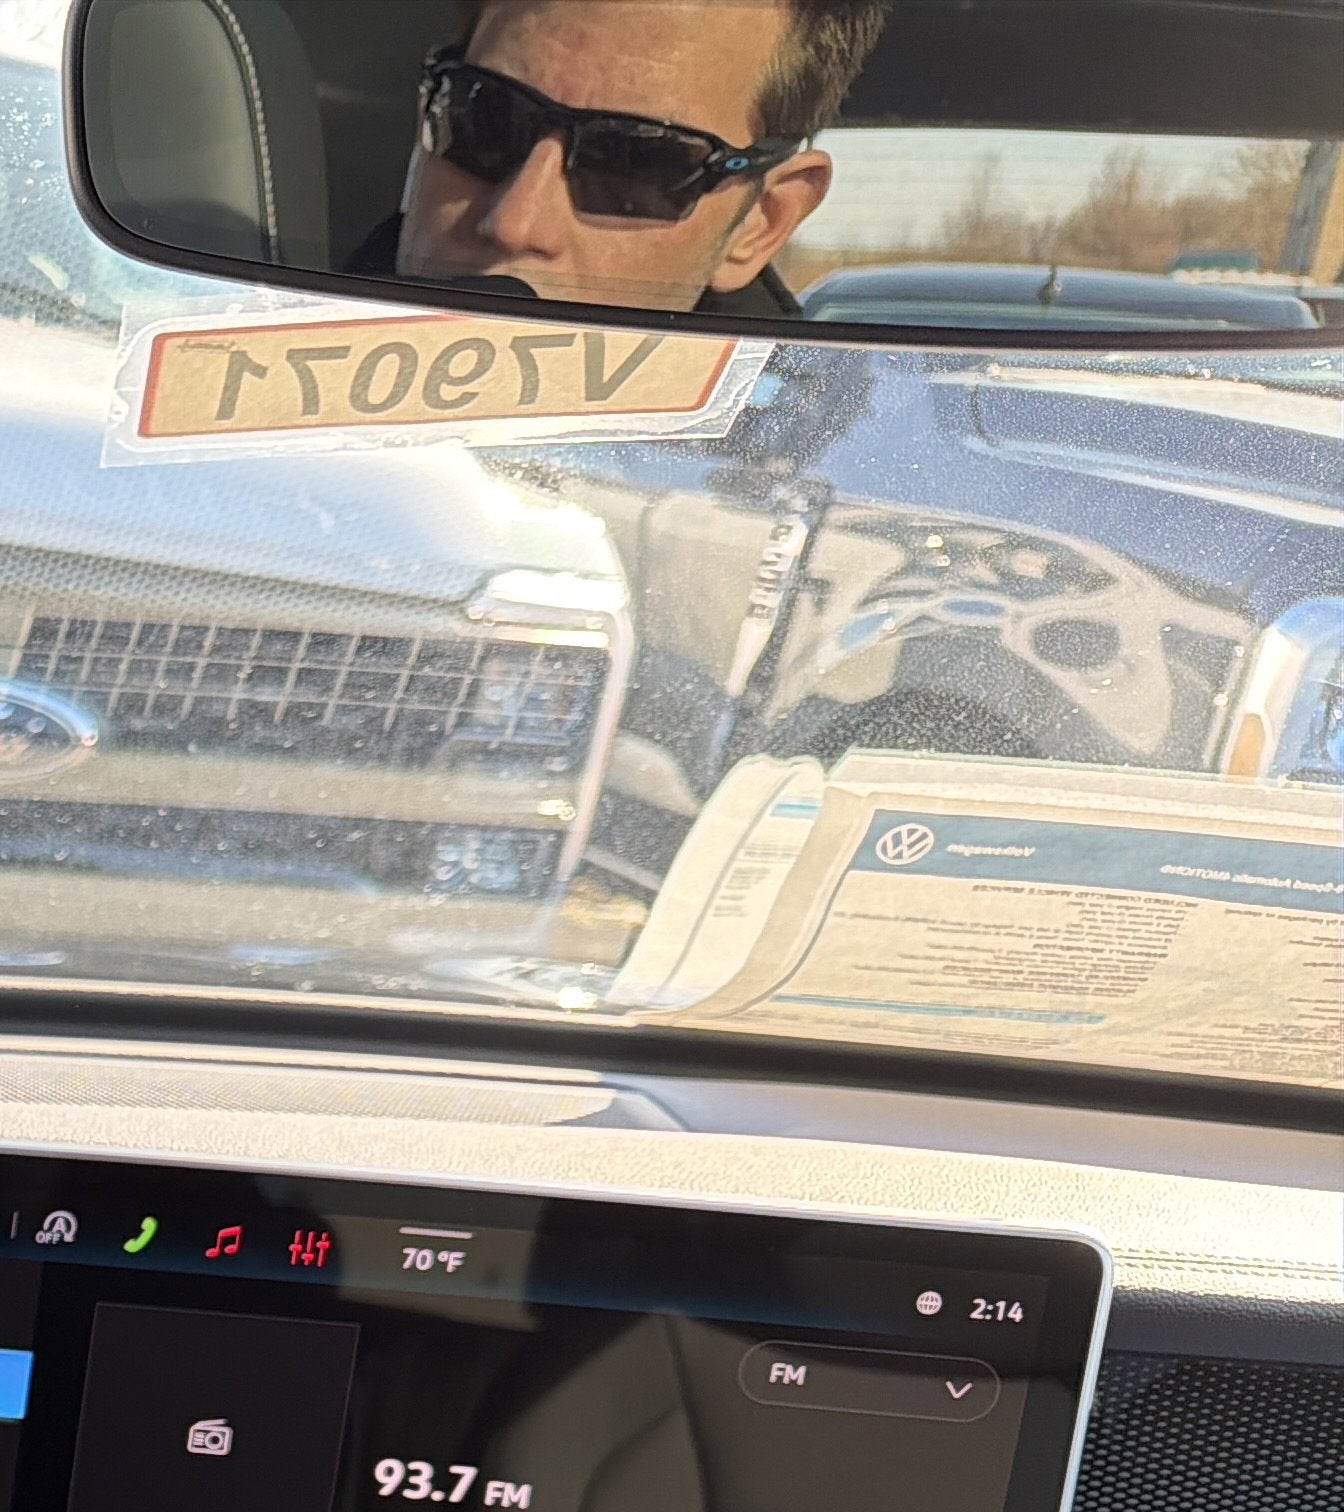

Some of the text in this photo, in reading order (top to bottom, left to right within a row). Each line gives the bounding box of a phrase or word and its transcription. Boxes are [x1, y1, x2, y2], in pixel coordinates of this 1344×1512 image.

[35, 1230, 61, 1245] OFF
[401, 1247, 433, 1271] 70
[969, 1298, 1023, 1323] 2:14
[769, 1362, 806, 1386] FM
[374, 1458, 532, 1509] 93.7 FM
